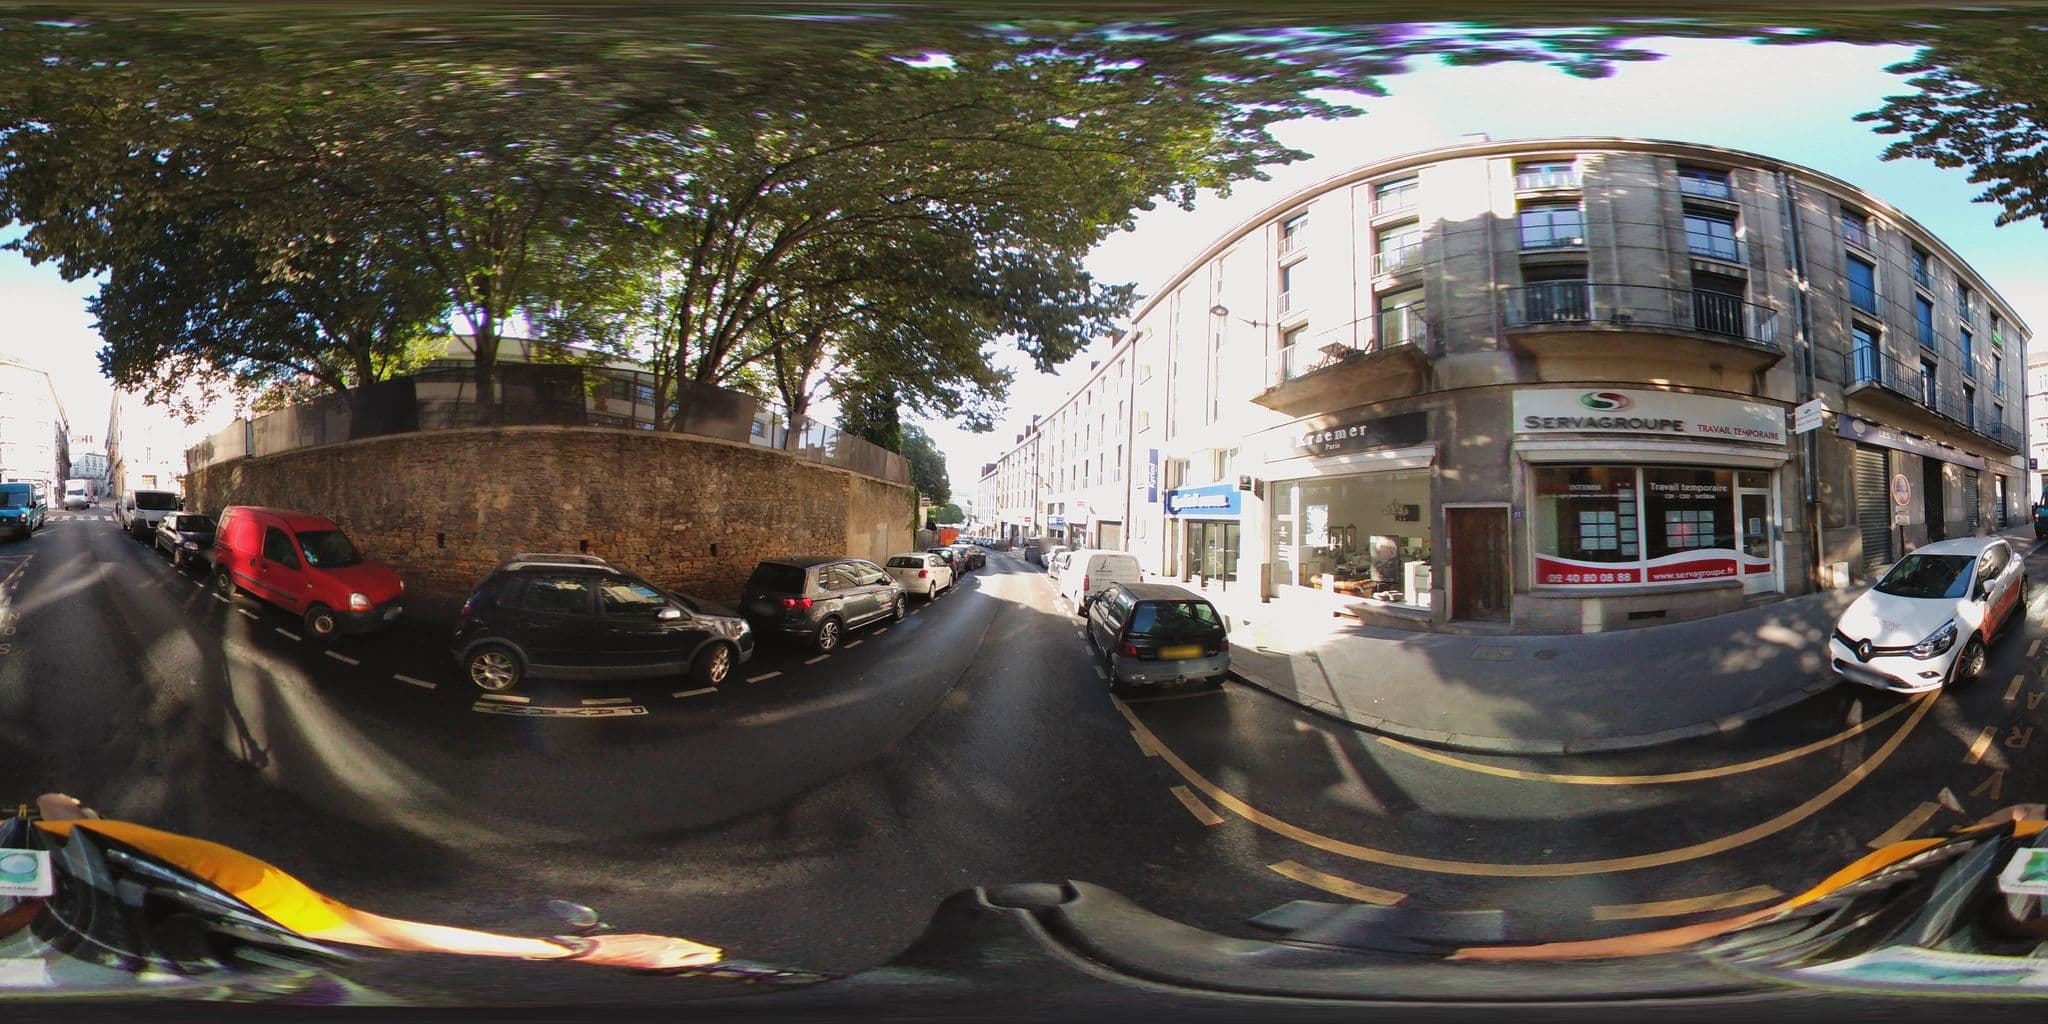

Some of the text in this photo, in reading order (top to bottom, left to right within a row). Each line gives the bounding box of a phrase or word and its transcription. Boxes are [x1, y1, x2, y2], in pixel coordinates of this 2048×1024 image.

[1525, 415, 1684, 431] SERVAGROUPE
[1698, 424, 1779, 439] TRAVAIL TEMPORAIRE
[1650, 482, 1728, 492] Travail temporaire
[1566, 574, 1580, 583] 40
[1583, 574, 1597, 583] 80
[1653, 567, 1734, 581] www.servagroupe.fr
